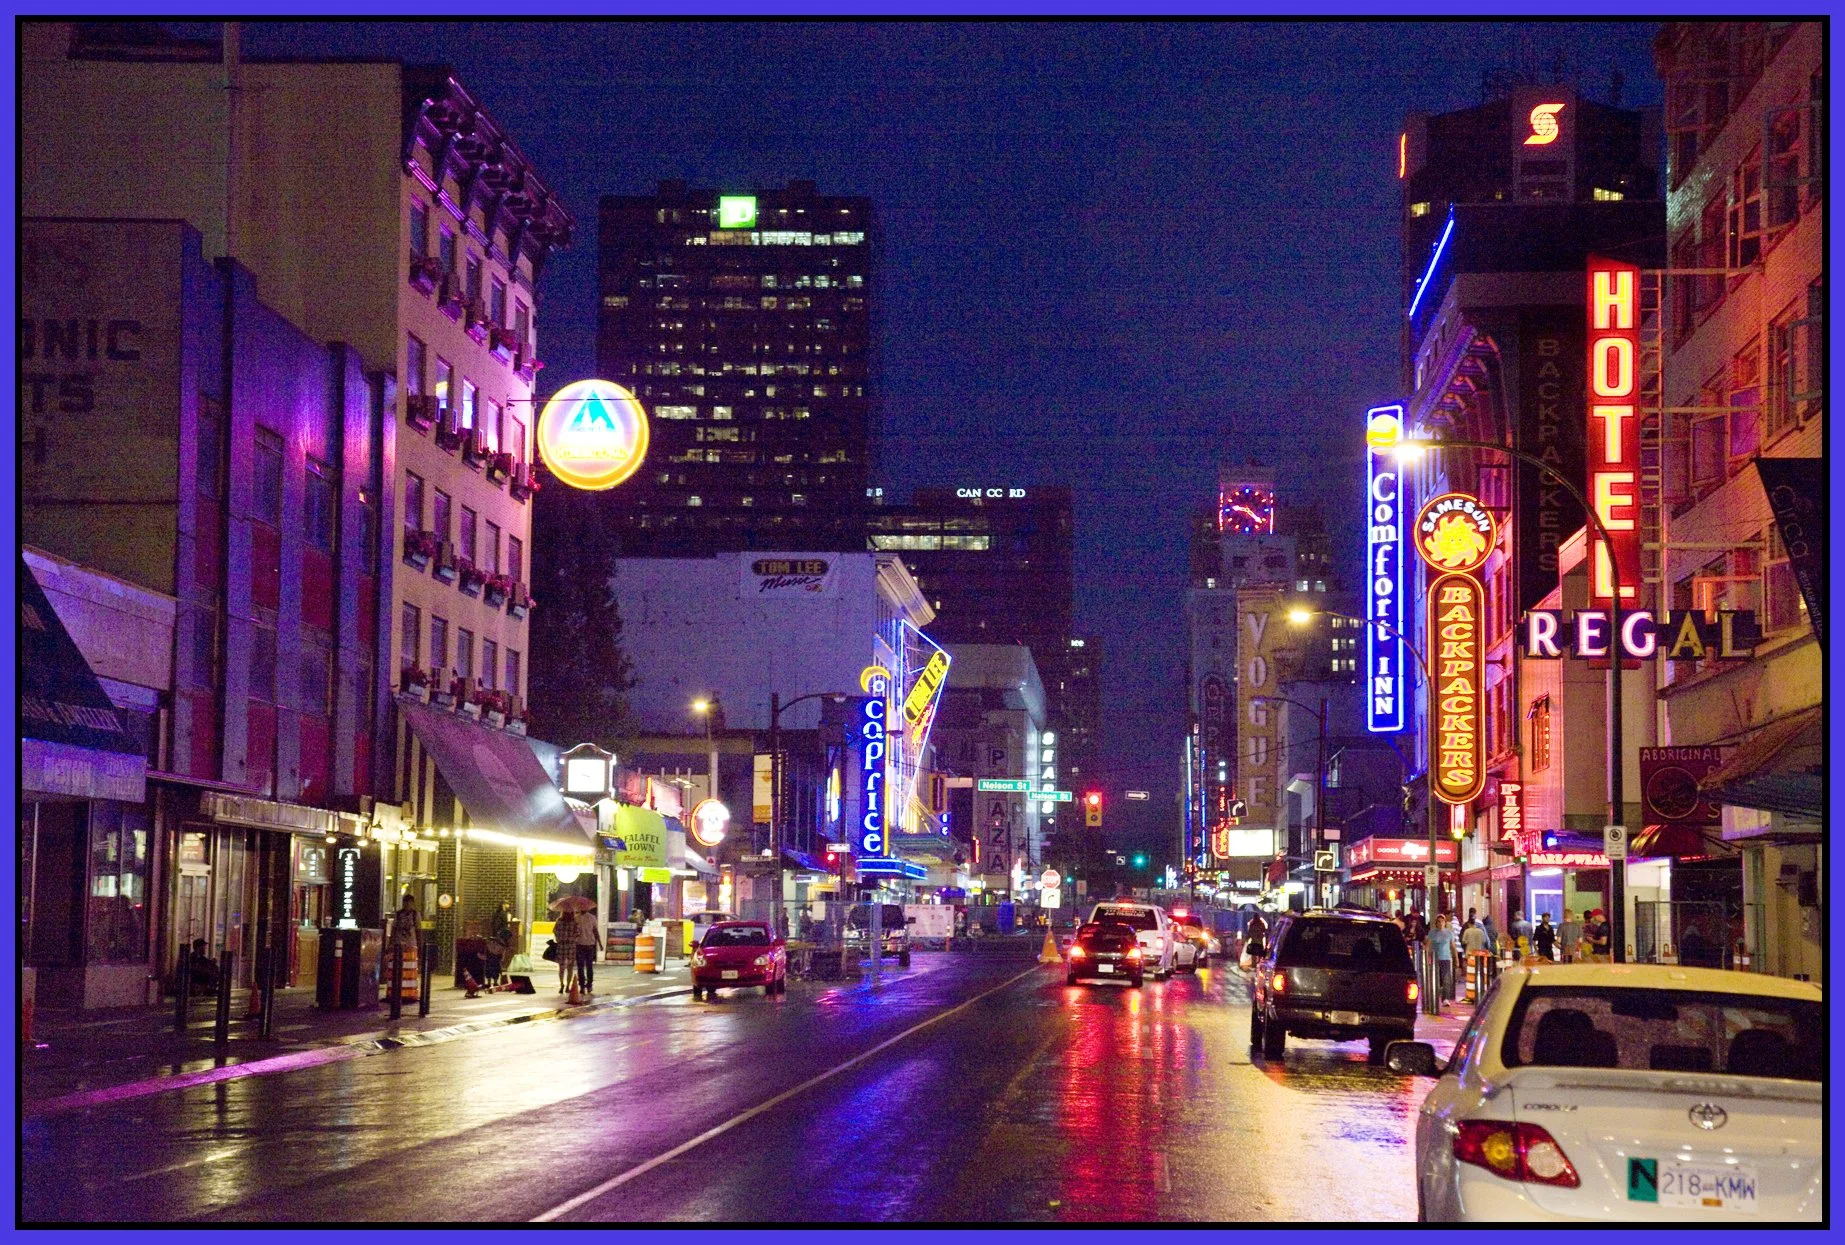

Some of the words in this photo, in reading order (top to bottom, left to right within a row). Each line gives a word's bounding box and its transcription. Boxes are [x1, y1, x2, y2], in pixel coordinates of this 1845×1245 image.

[1538, 338, 1561, 573] BACKPACKERS
[1593, 271, 1635, 598] HOTEL
[1421, 498, 1490, 532] SAMESUN
[760, 562, 790, 574] TOM
[797, 562, 821, 573] LEE
[1372, 472, 1398, 641] Comfort
[759, 575, 822, 592] Music
[1527, 611, 1753, 658] REGAL
[1247, 611, 1268, 808] VOGUE
[1374, 656, 1394, 715] INN
[1438, 587, 1475, 786] BACKPACKERS
[1642, 748, 1720, 761] ABORIGINAL
[982, 781, 1013, 789] Nelson
[1017, 781, 1027, 789] St
[991, 749, 1006, 871] PAZA
[1501, 783, 1521, 841] PIZZA
[624, 833, 660, 845] FALAFEL
[629, 842, 655, 852] TOWN
